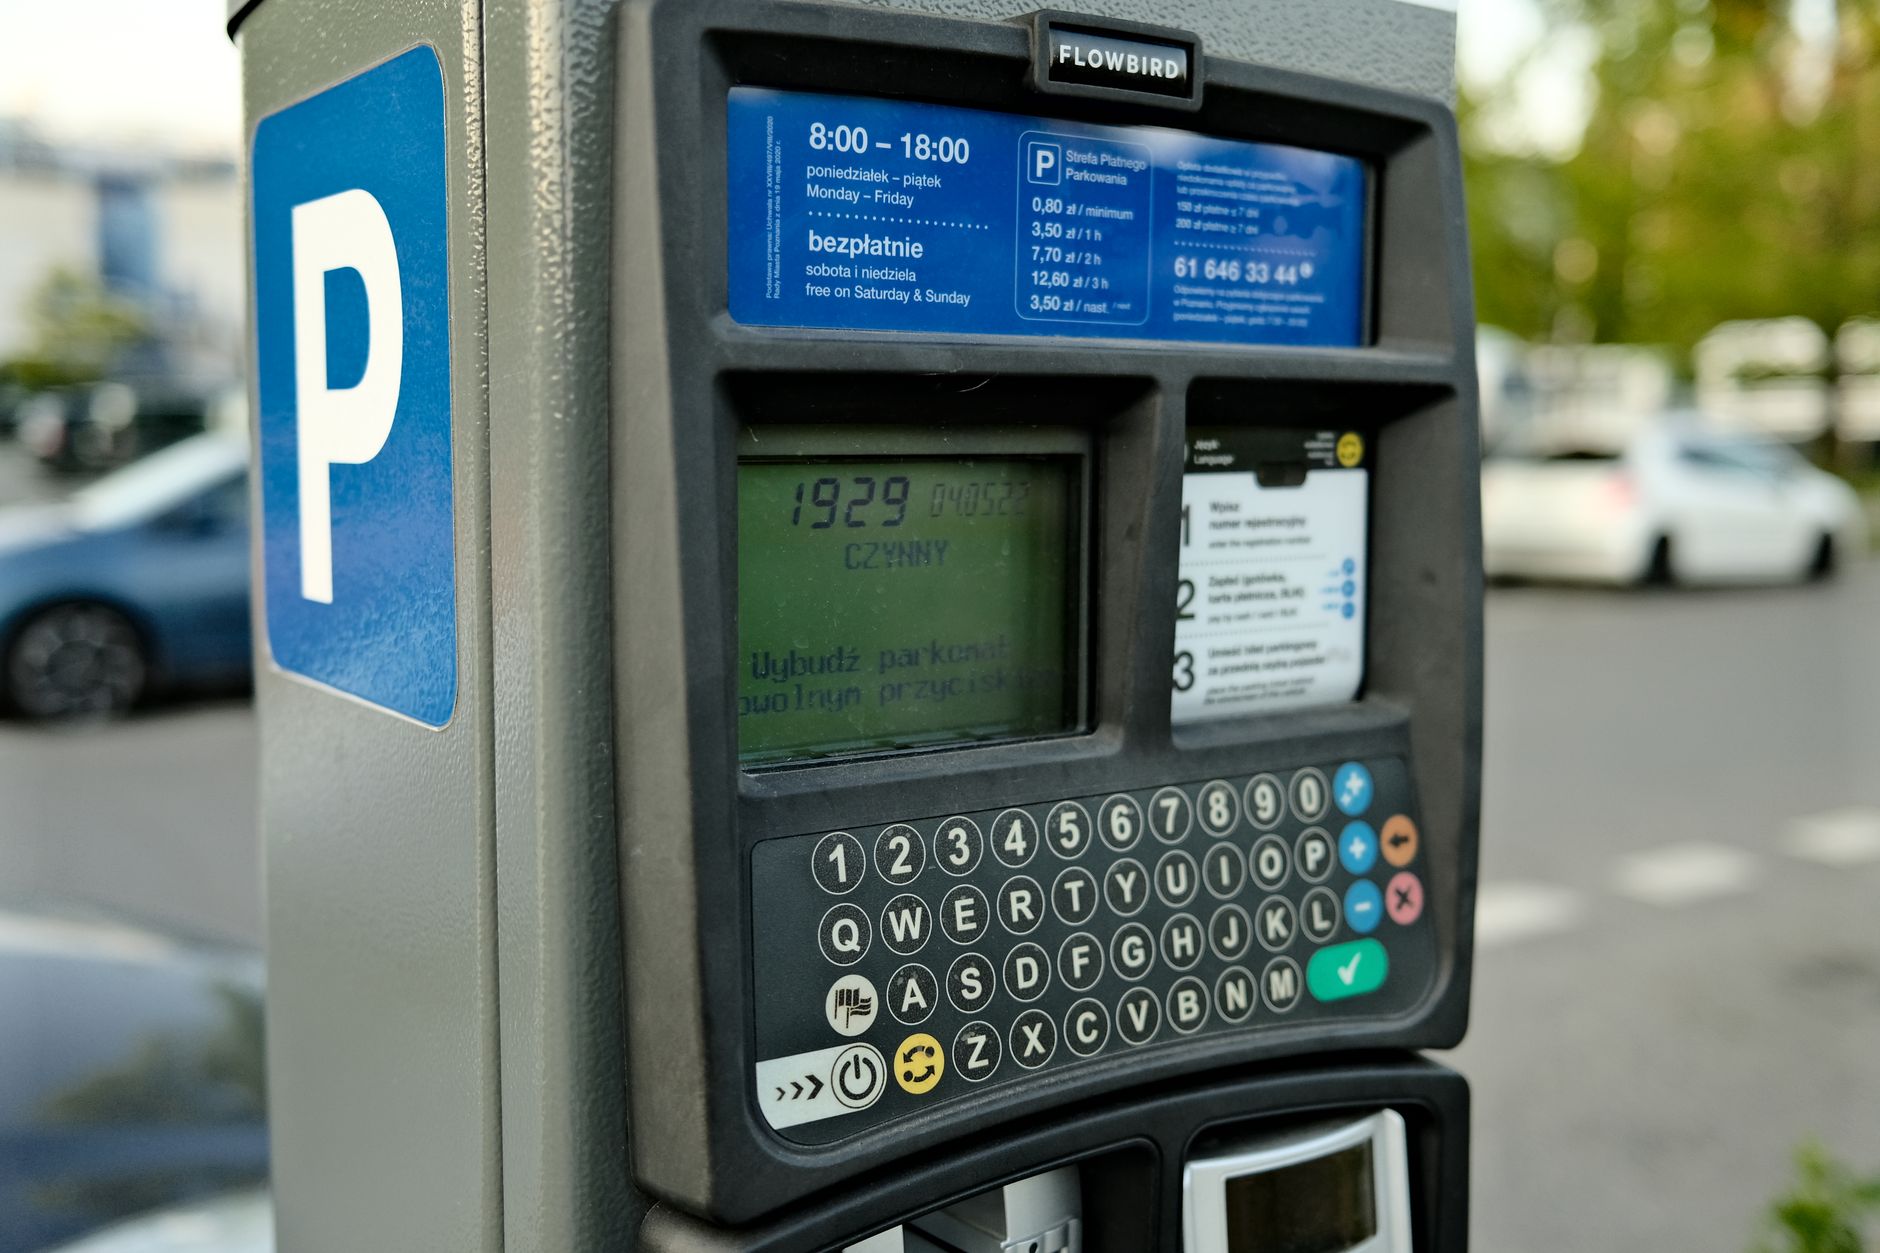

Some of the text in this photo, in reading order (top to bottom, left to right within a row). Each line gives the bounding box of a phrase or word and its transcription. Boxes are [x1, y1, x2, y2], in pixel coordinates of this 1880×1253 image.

[1060, 44, 1179, 79] FLOWBIRD
[809, 122, 868, 154] 8:00
[900, 133, 970, 164] 18:00
[1036, 150, 1055, 178] P
[1066, 150, 1098, 166] Strefa
[806, 165, 889, 183] poniedziałek
[903, 173, 942, 190] piątek
[1066, 168, 1128, 186] Parkowania
[806, 183, 860, 204] Monday
[875, 190, 914, 209] Friday
[1032, 197, 1062, 216] 0,80
[1066, 204, 1076, 216] zł
[1085, 205, 1133, 220] minimum
[809, 229, 924, 259] bezpłatnie
[1031, 221, 1062, 239] 3,50
[1066, 228, 1076, 240] zł
[1086, 229, 1091, 241] 1
[1094, 229, 1102, 241] h
[1031, 246, 1061, 264] 7,70
[1065, 253, 1075, 264] zł
[1084, 254, 1092, 265] 2
[1094, 254, 1102, 265] h
[806, 263, 917, 282] sobota i niedziela
[1031, 270, 1069, 288] 12,60
[1073, 277, 1083, 288] zł
[1091, 278, 1099, 289] 3
[1101, 278, 1109, 290] h
[1174, 258, 1298, 285] 61 646 33 44
[805, 282, 971, 308] free on Saturday & Sunday
[1030, 295, 1060, 312] 3,50
[1063, 300, 1074, 312] zł
[292, 188, 404, 605] P
[793, 477, 910, 529] 1929
[843, 540, 949, 570] CZYNNY
[1176, 579, 1195, 620] 2
[752, 646, 860, 683] Wybudź
[1173, 651, 1194, 692] 3
[828, 777, 1320, 883] 1 2 3 4 5 6 7 8 9 0
[831, 839, 1326, 952] Q W E R T Y U I O P
[901, 900, 1331, 1013] A S D F G H J K L
[964, 968, 1295, 1070] Z X C V B N M
